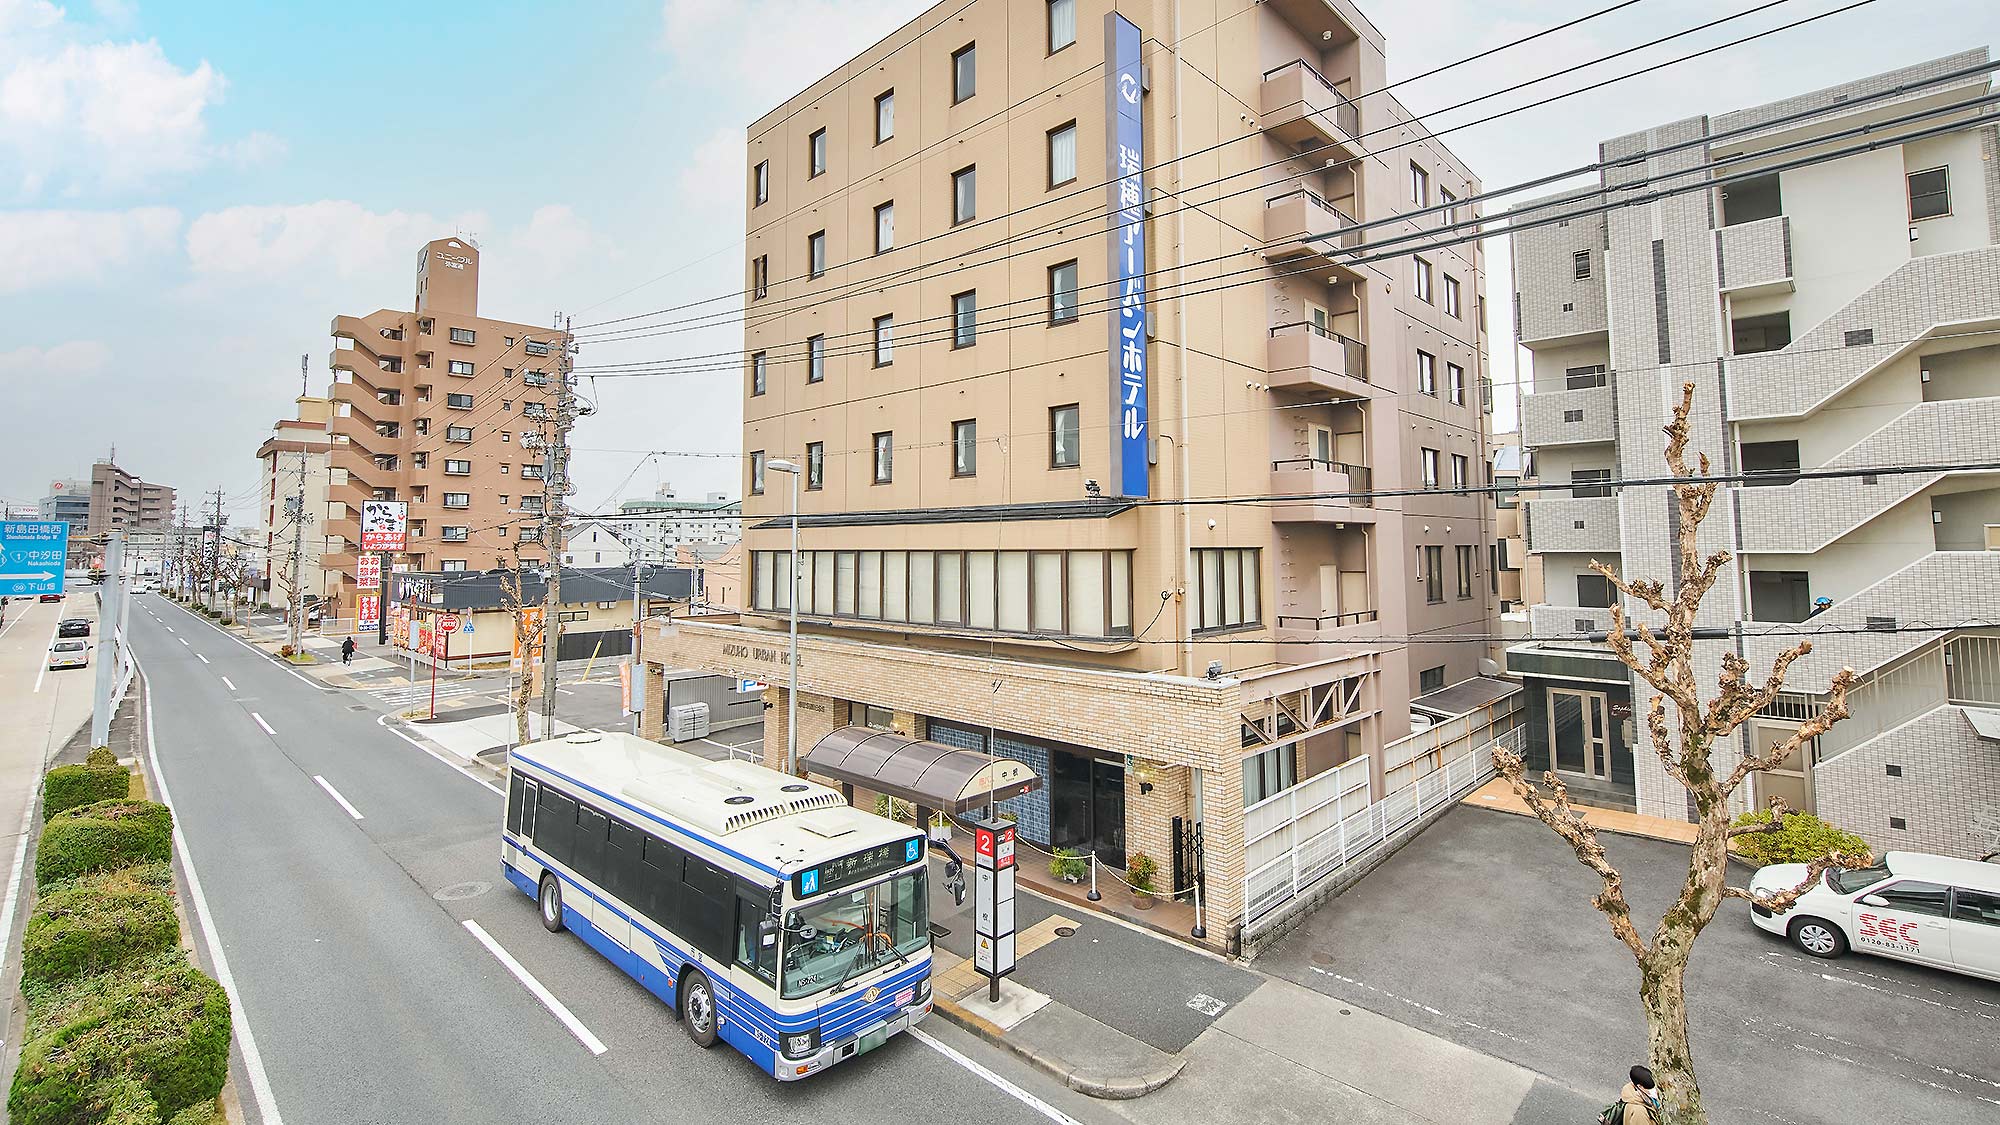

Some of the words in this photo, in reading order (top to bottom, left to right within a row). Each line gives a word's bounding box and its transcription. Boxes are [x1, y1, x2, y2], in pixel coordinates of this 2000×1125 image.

[28, 550, 62, 560] 中汐田
[358, 557, 369, 587] お惣菜
[369, 557, 380, 587] お弁当
[722, 643, 749, 659] MIZUHO
[753, 647, 777, 663] URBAN
[742, 679, 756, 692] P
[980, 834, 991, 852] 2
[1007, 830, 1014, 840] 2
[1859, 913, 1919, 946] SEC
